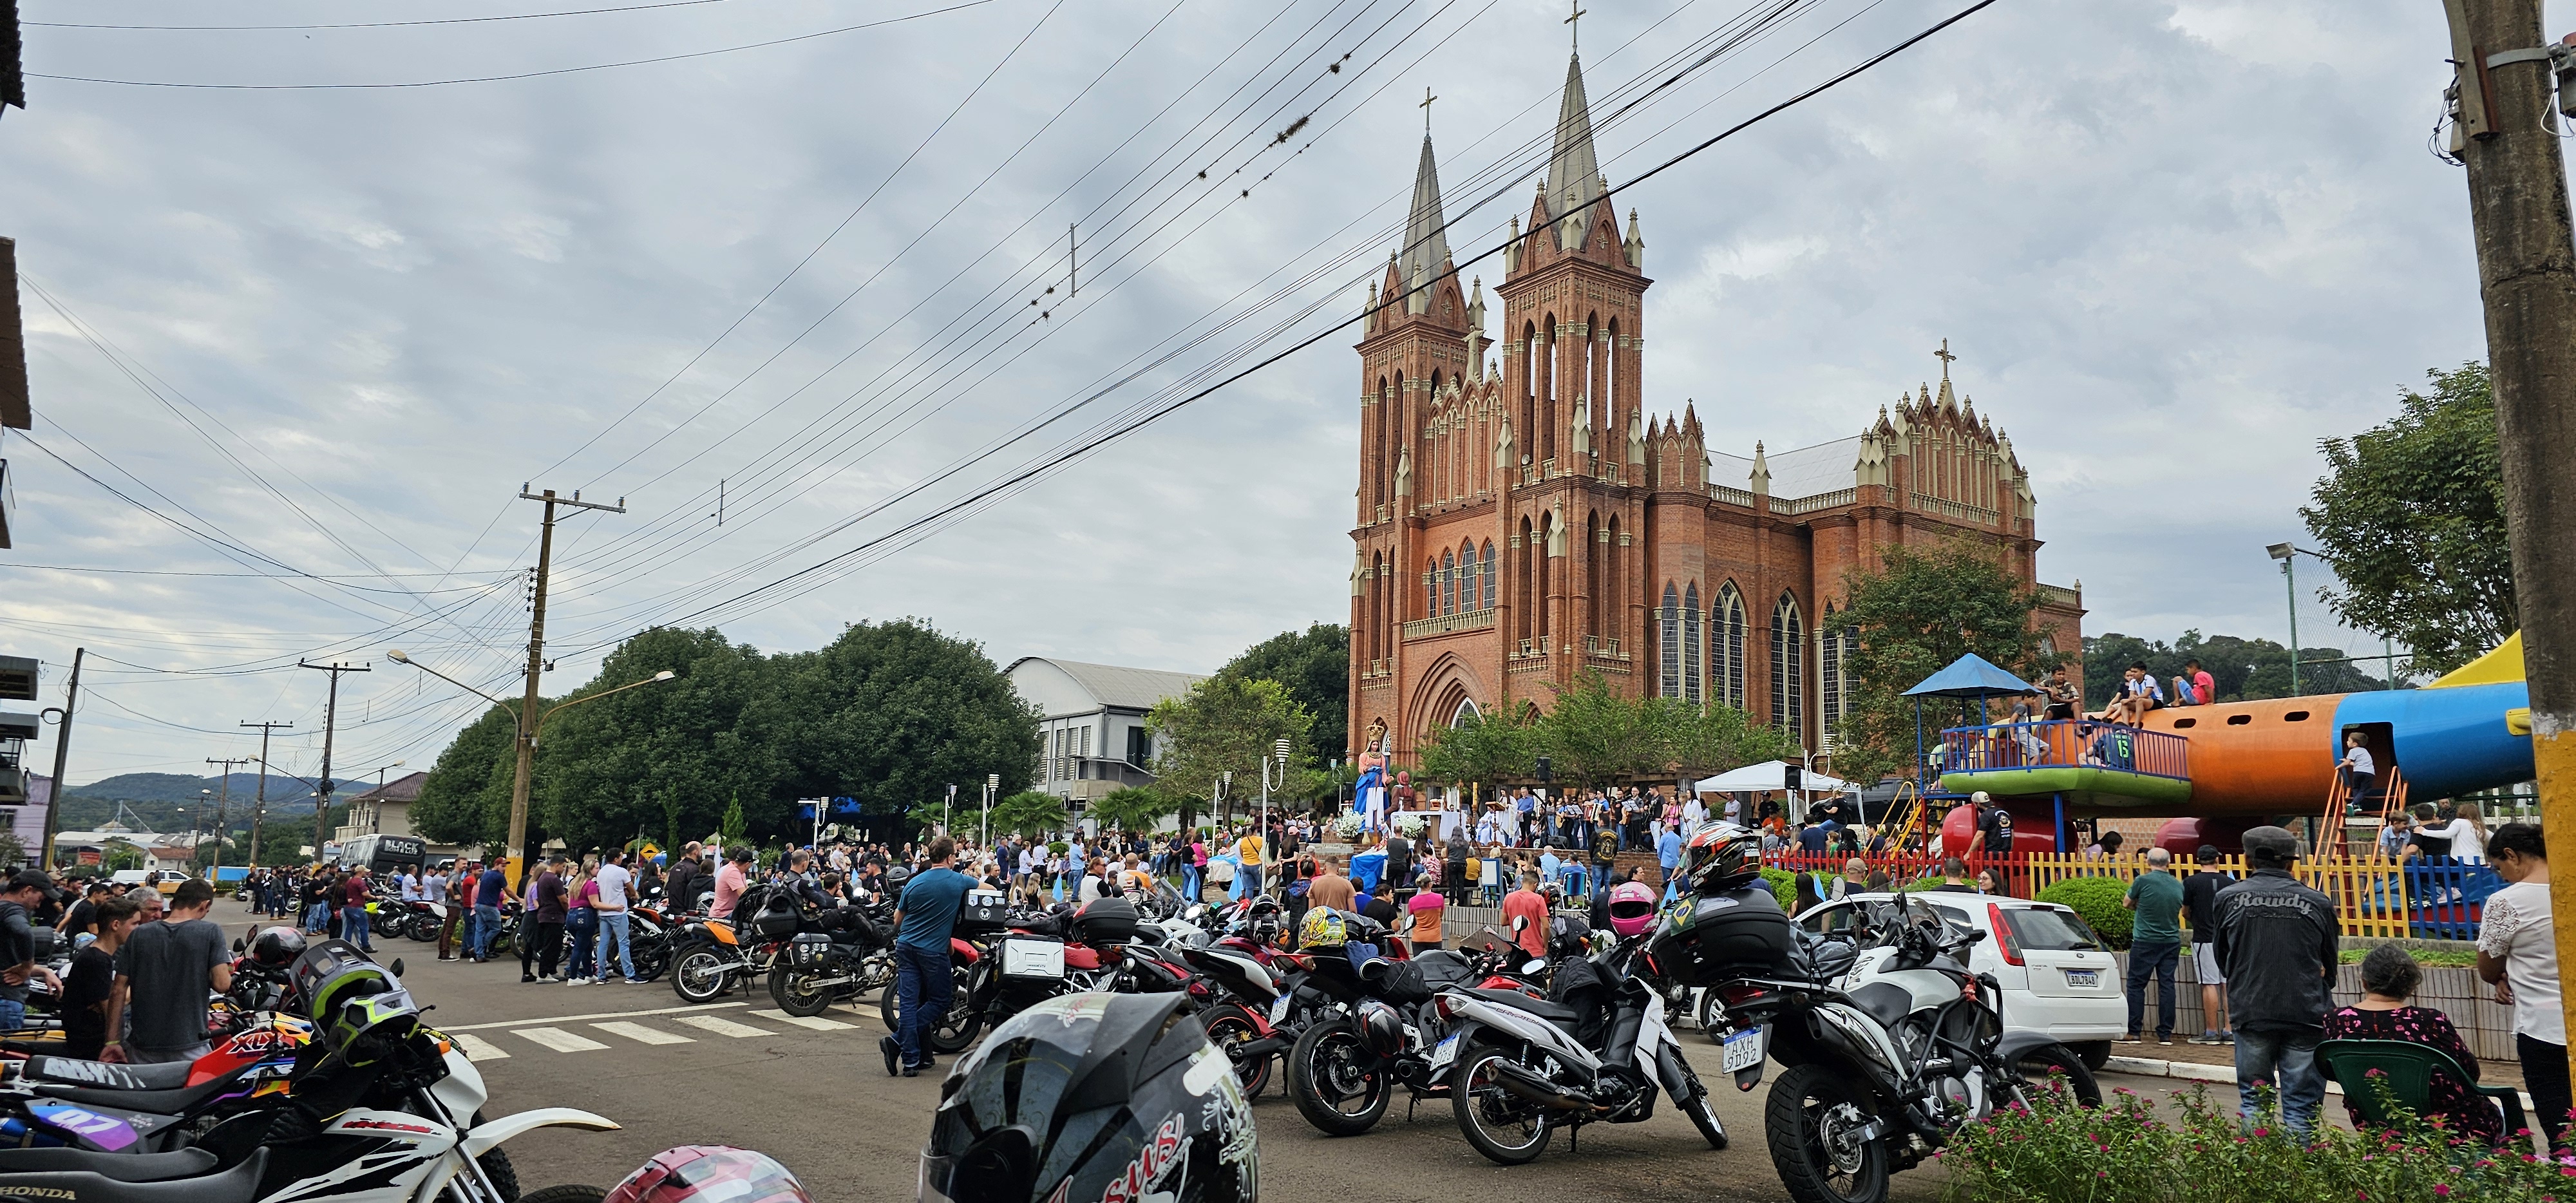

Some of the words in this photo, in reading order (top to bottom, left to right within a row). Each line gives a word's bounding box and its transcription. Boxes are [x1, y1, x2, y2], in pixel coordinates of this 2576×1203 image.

[384, 839, 419, 853] BLACK
[2233, 891, 2313, 915] Rowdy
[1732, 1035, 1754, 1055] AXH
[1727, 1048, 1757, 1070] 9D92
[0, 1186, 77, 1200] HONDA
